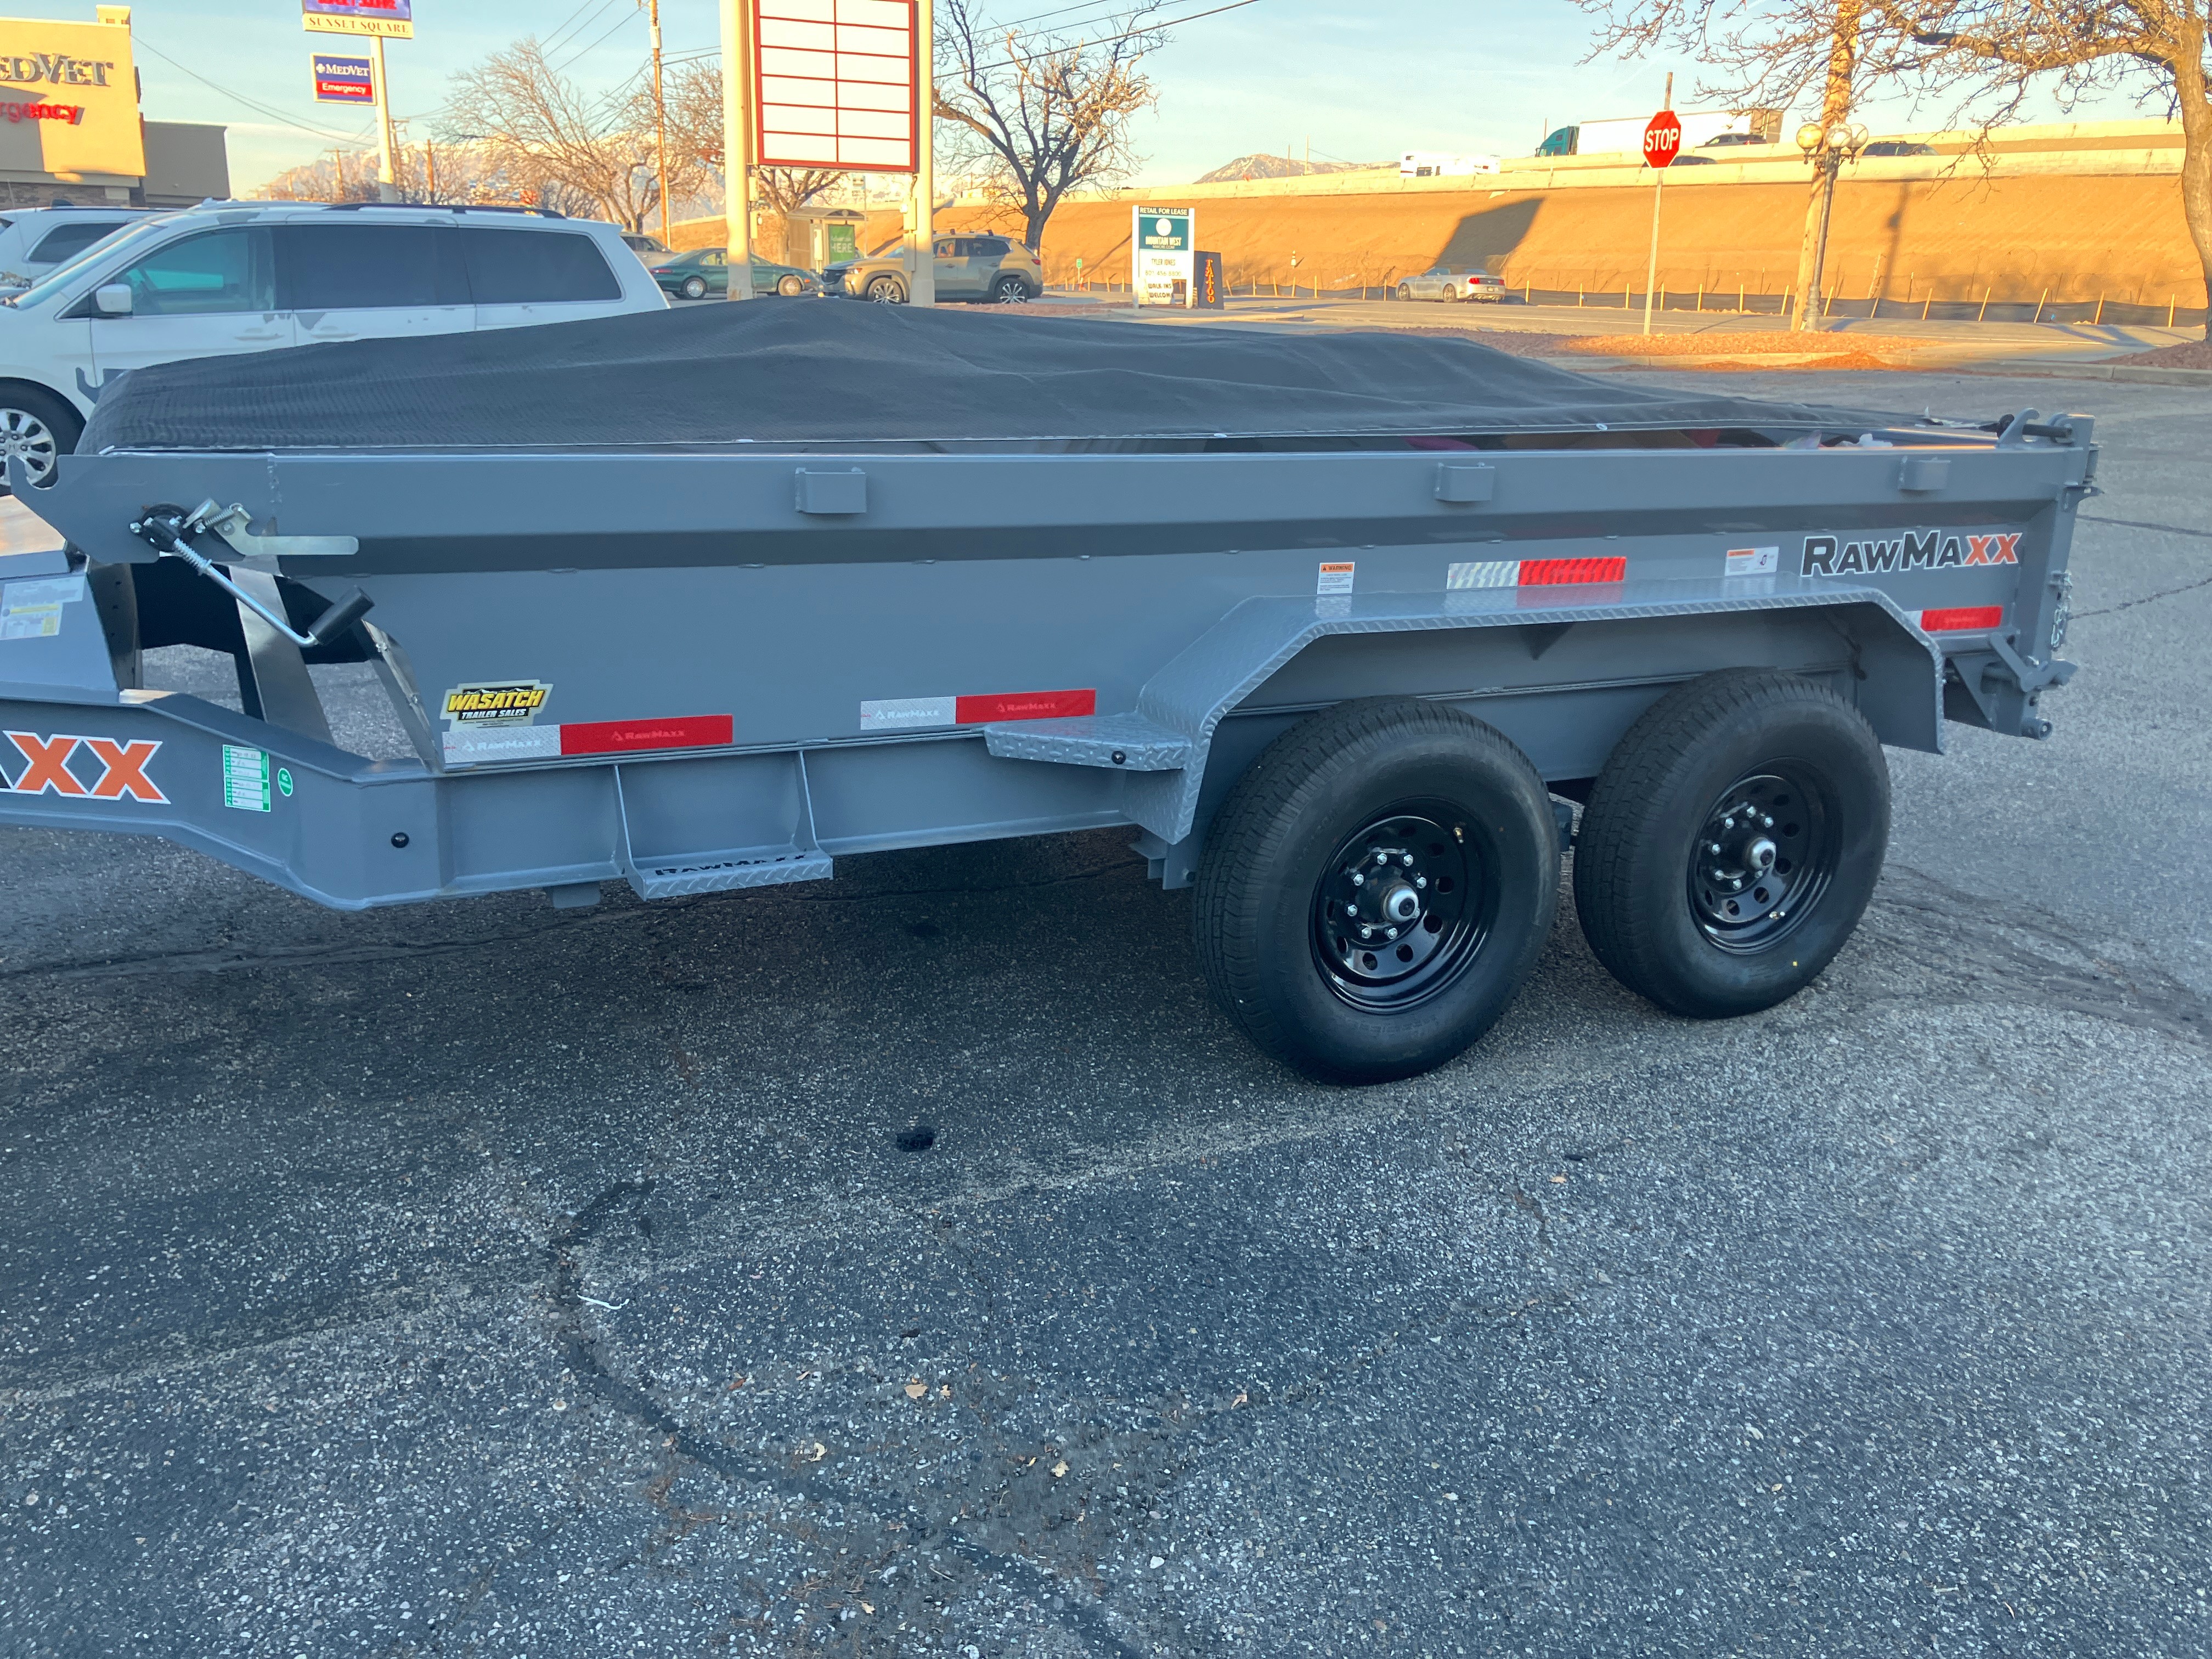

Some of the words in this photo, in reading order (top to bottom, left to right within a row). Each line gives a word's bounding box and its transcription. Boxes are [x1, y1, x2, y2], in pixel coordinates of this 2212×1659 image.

[309, 17, 356, 29] SUNSET
[360, 21, 409, 33] SQUARE
[321, 82, 366, 95] Emergency
[1645, 128, 1679, 153] STOP
[1169, 237, 1182, 246] WEST
[447, 690, 547, 712] WASATCH
[461, 710, 498, 720] TRAILER
[498, 708, 527, 718] SALES
[0, 730, 171, 804] XX
